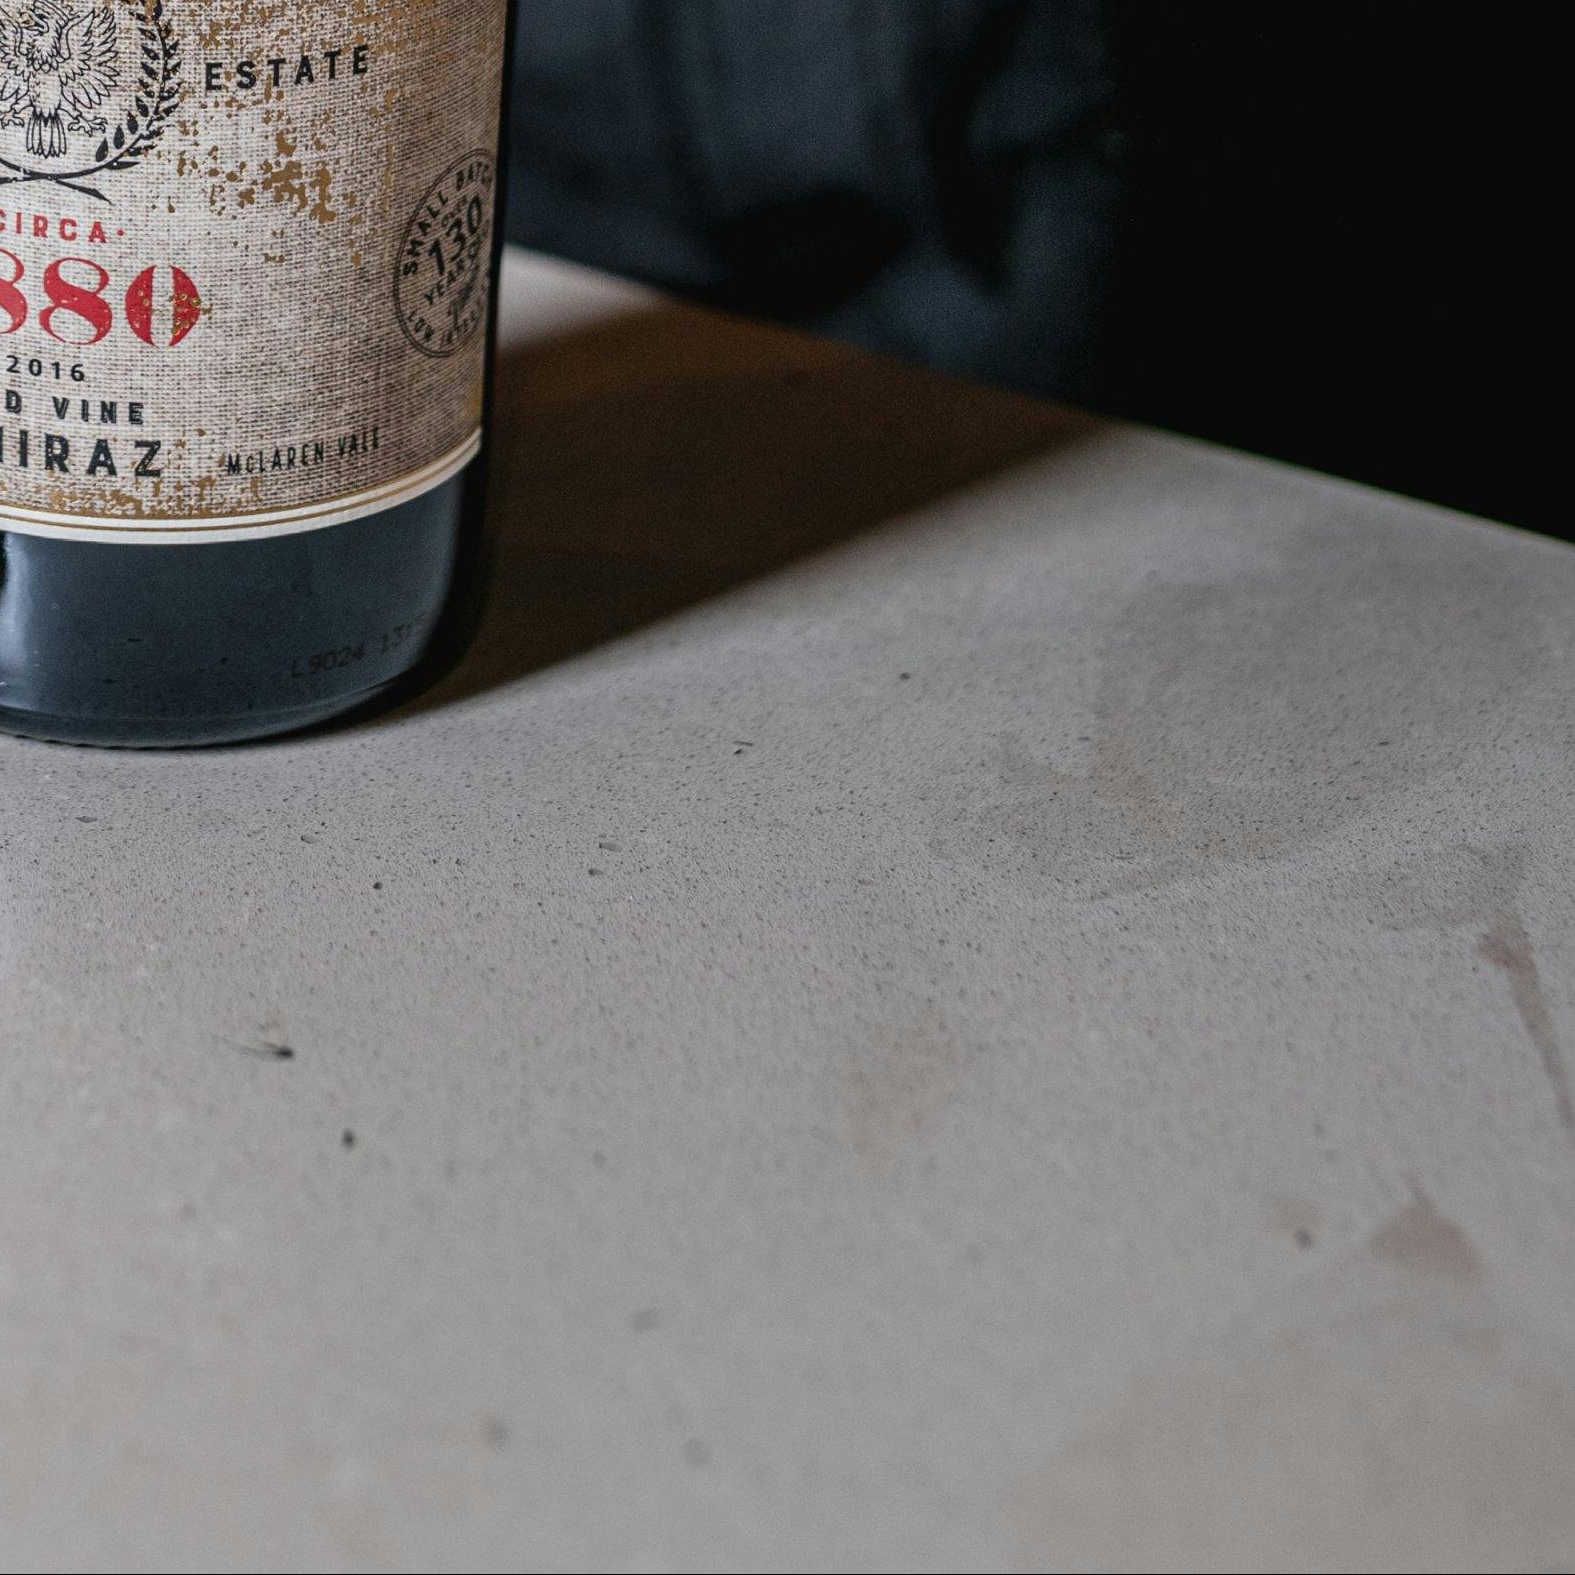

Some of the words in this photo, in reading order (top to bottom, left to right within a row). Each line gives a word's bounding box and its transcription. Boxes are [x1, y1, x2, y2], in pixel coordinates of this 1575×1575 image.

[206, 46, 369, 92] ESTATE
[402, 190, 449, 277] SMALL
[428, 194, 482, 277] 130
[5, 355, 86, 382] 2016
[51, 396, 145, 425] VINE
[226, 441, 325, 476] McLAREN
